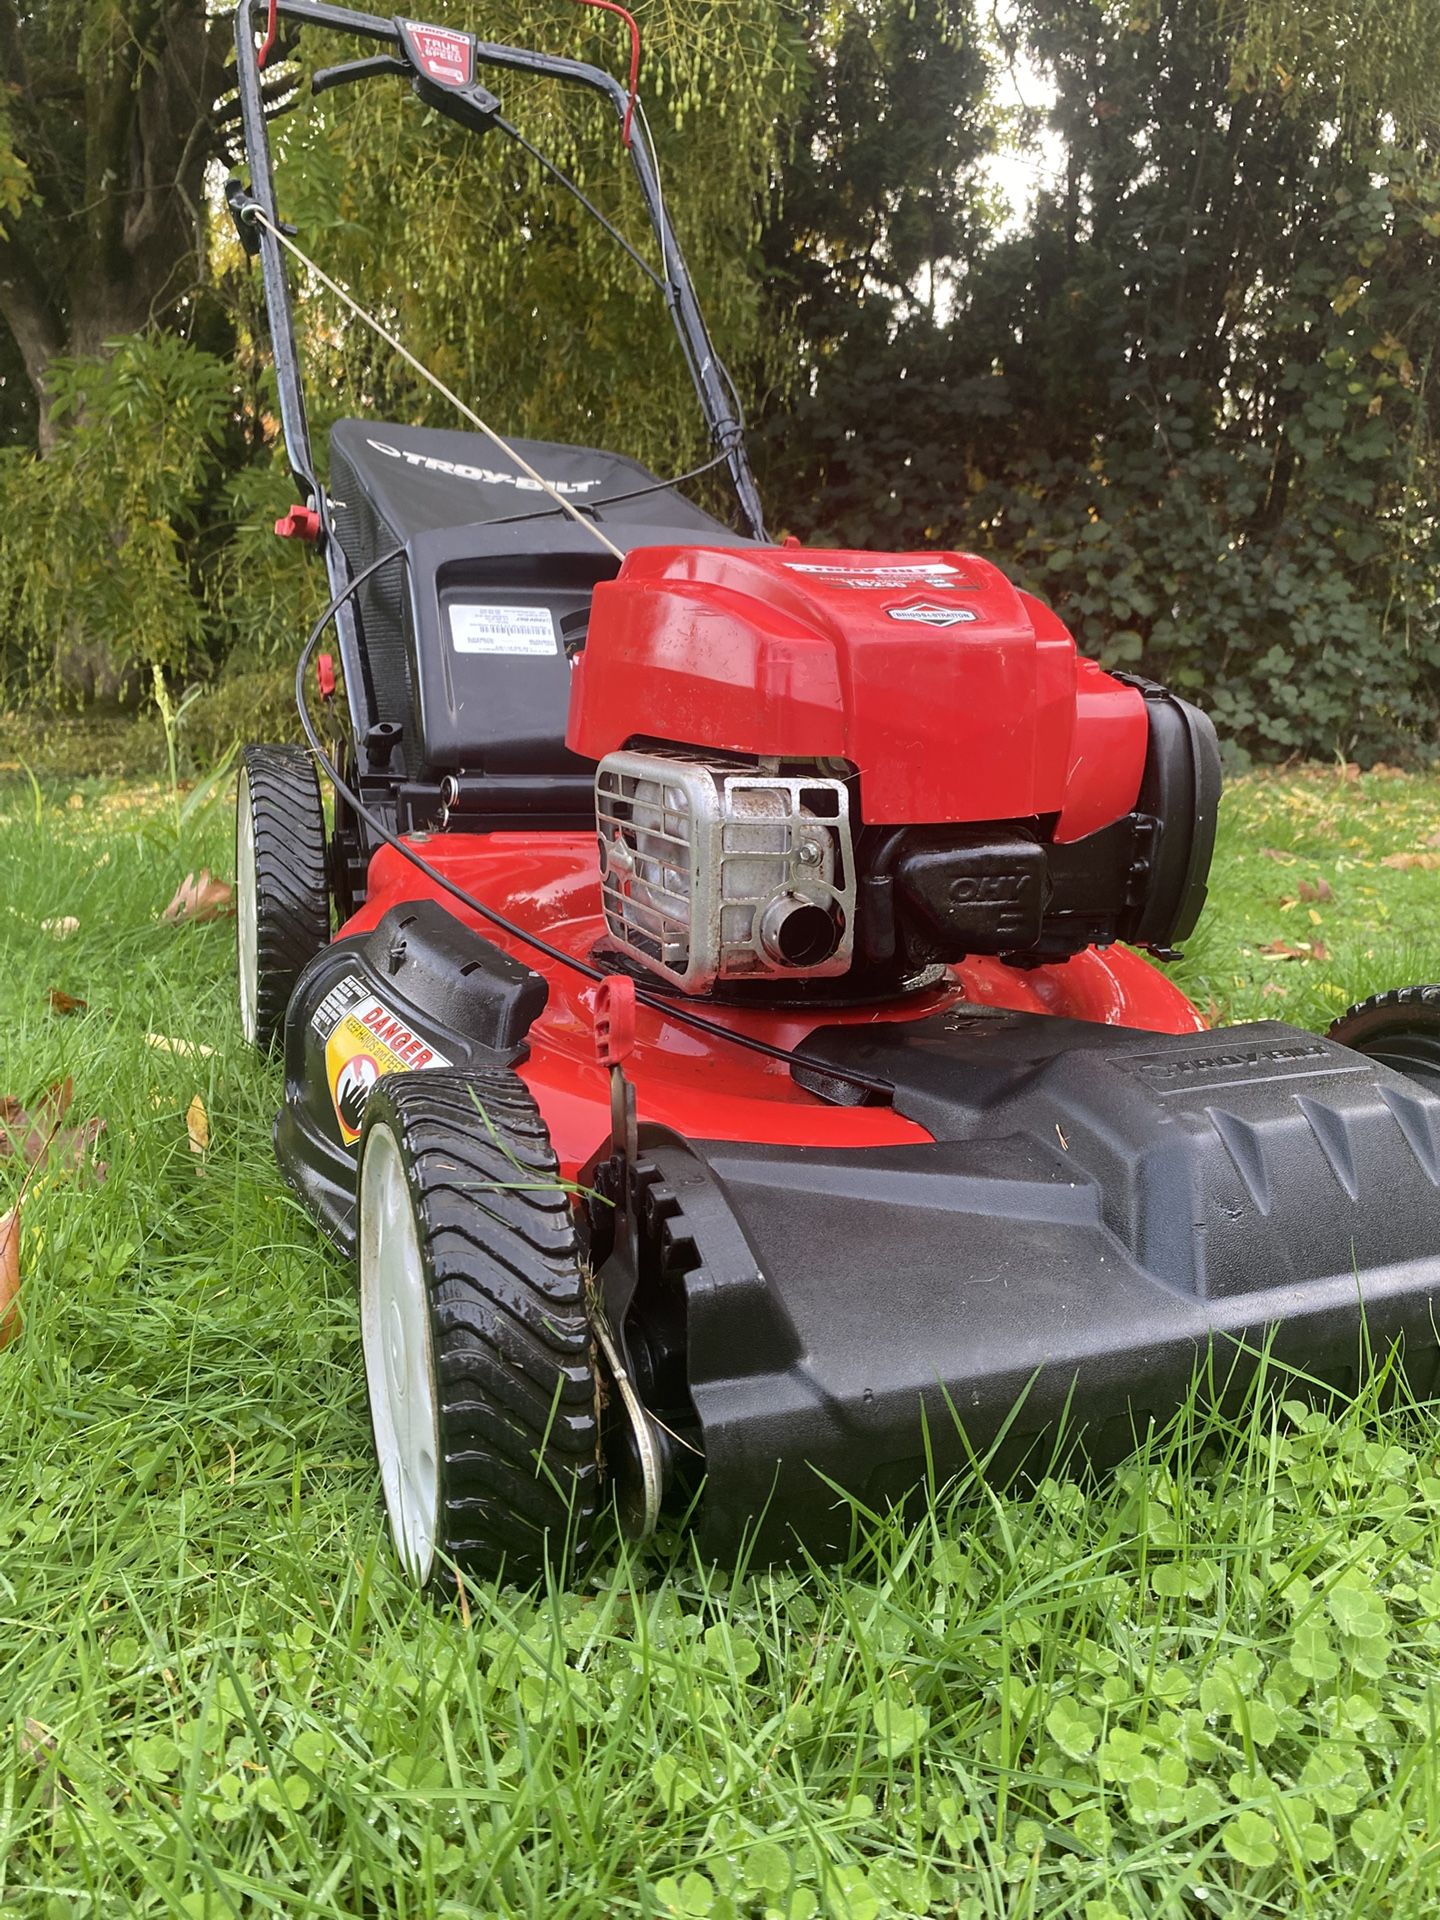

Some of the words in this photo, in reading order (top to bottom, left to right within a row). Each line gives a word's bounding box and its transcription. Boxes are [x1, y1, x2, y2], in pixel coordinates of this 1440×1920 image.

[423, 38, 460, 51] TRUE
[424, 48, 463, 63] SPEED
[344, 1016, 361, 1036] KEEP
[357, 1027, 379, 1052] HANDS
[373, 1046, 389, 1061] and
[361, 1006, 433, 1071] DANGER
